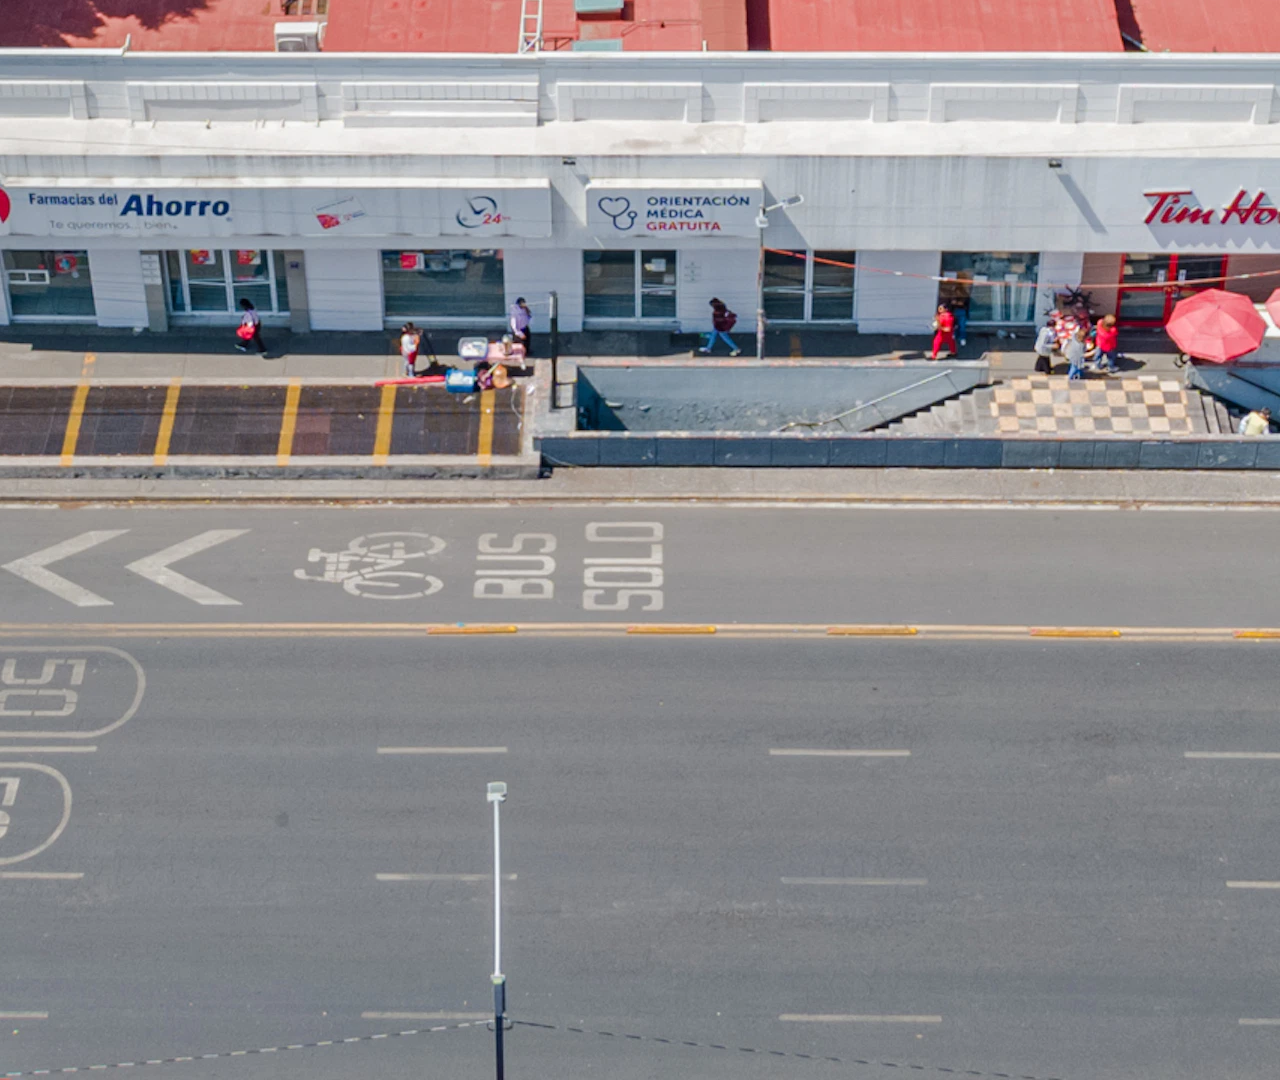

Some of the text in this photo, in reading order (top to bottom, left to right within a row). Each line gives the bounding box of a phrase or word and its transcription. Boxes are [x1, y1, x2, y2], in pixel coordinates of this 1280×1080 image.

[29, 193, 230, 217] Farmacias del Ahorro
[646, 195, 750, 206] ORIENTACIÓN
[646, 207, 704, 219] MÉDICA
[1143, 189, 1214, 225] Tim
[50, 220, 63, 229] Te
[483, 213, 502, 225] 24
[646, 221, 721, 231] GRATUITA
[473, 532, 557, 599] BUS
[582, 521, 664, 611] SOLO
